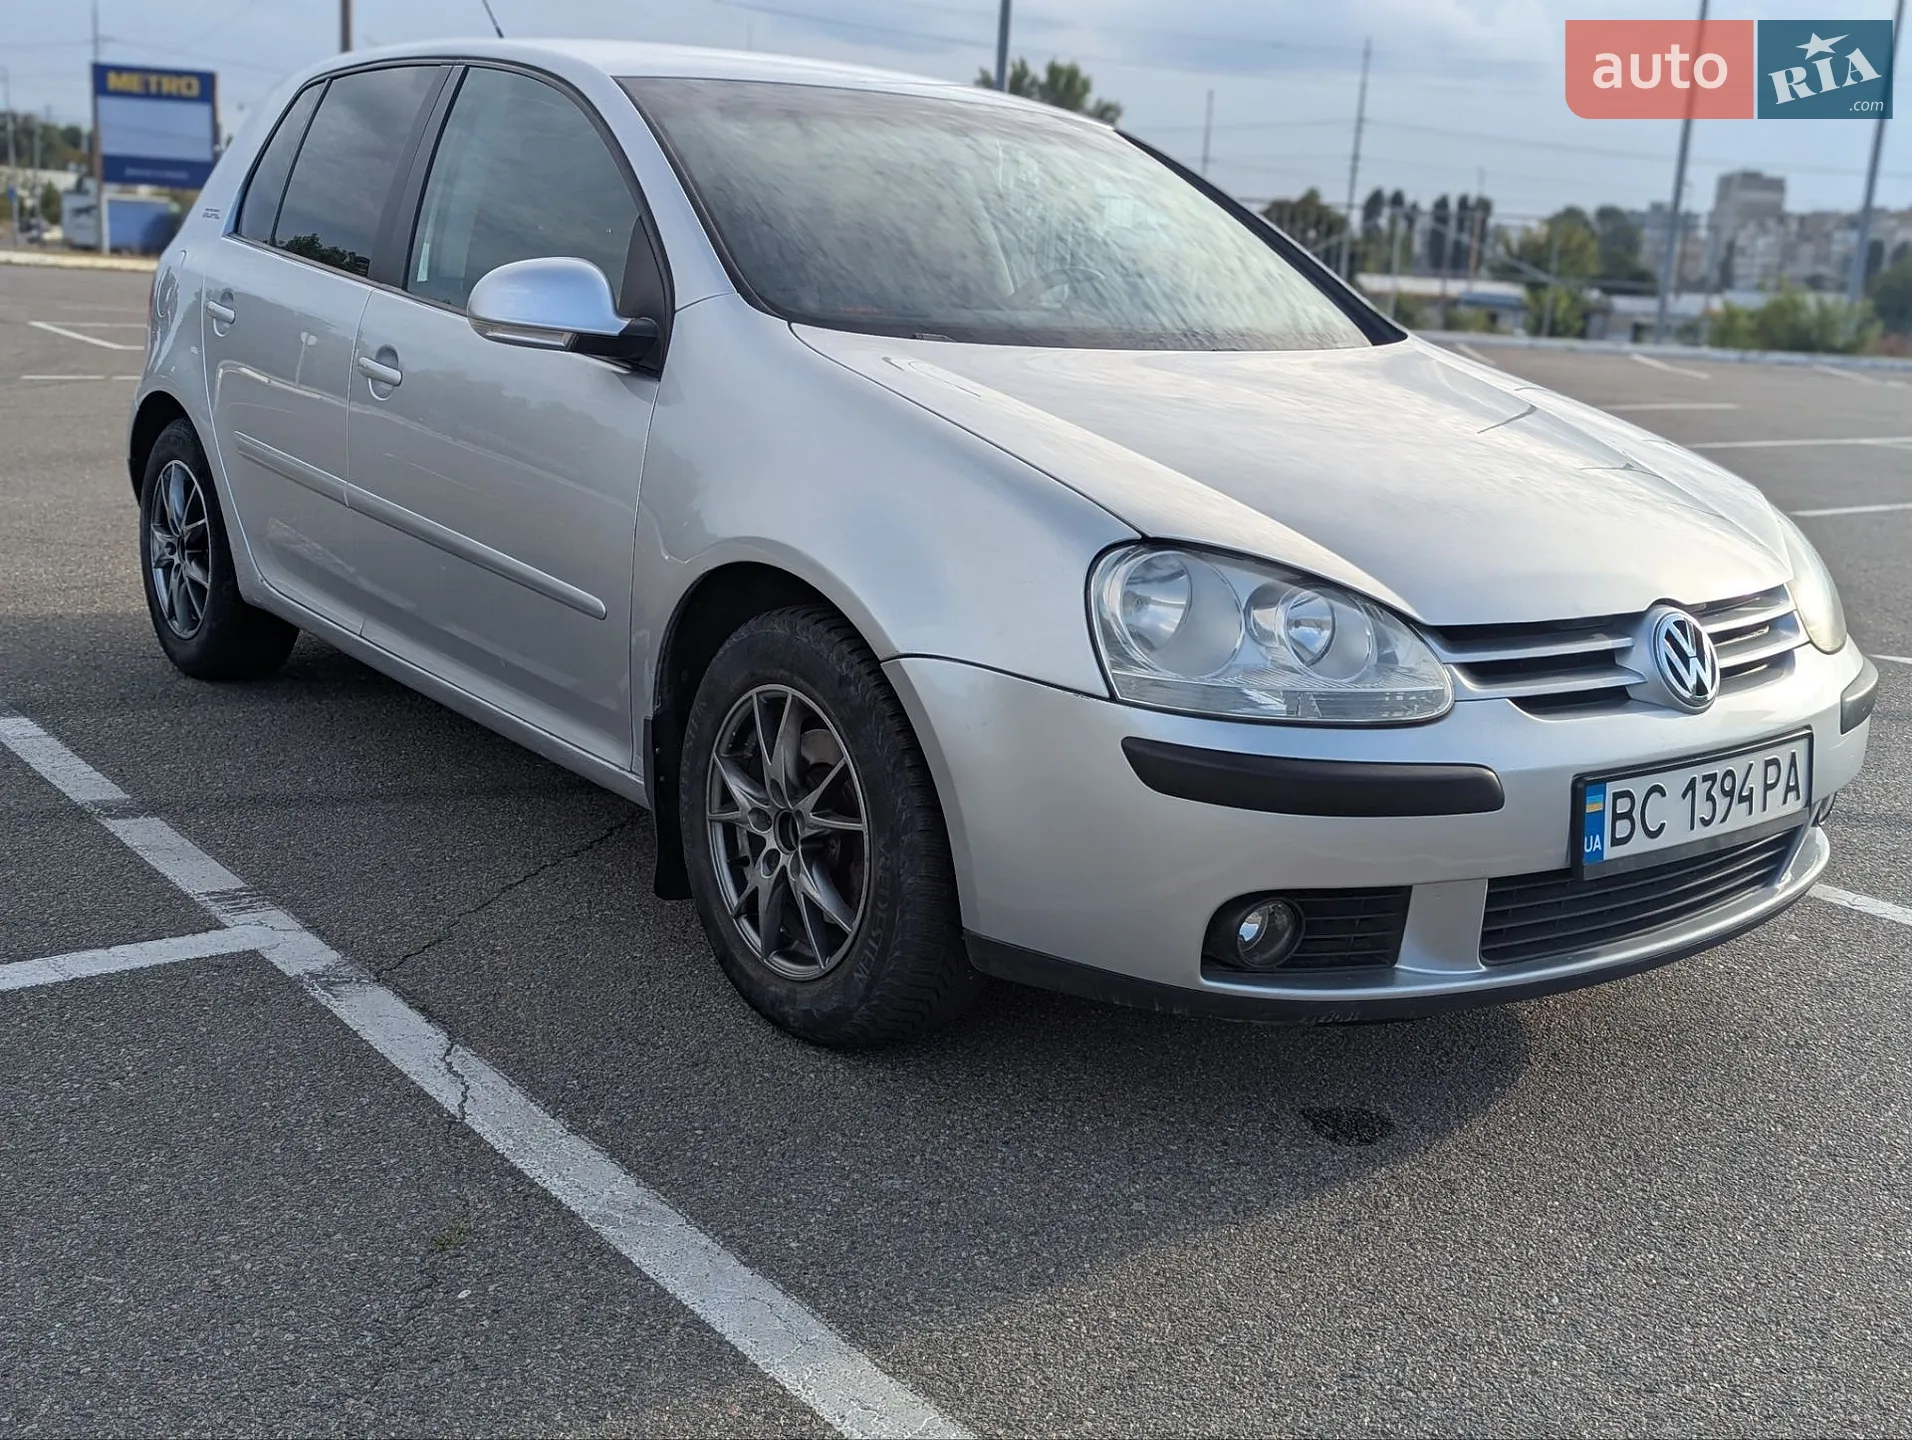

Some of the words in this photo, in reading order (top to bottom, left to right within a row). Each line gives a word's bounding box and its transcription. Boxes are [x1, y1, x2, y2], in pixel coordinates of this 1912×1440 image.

[107, 71, 200, 97] METRO
[1610, 784, 1667, 848] BC
[1681, 762, 1754, 831] 1394
[1762, 751, 1801, 812] PA
[1584, 833, 1602, 853] UA
